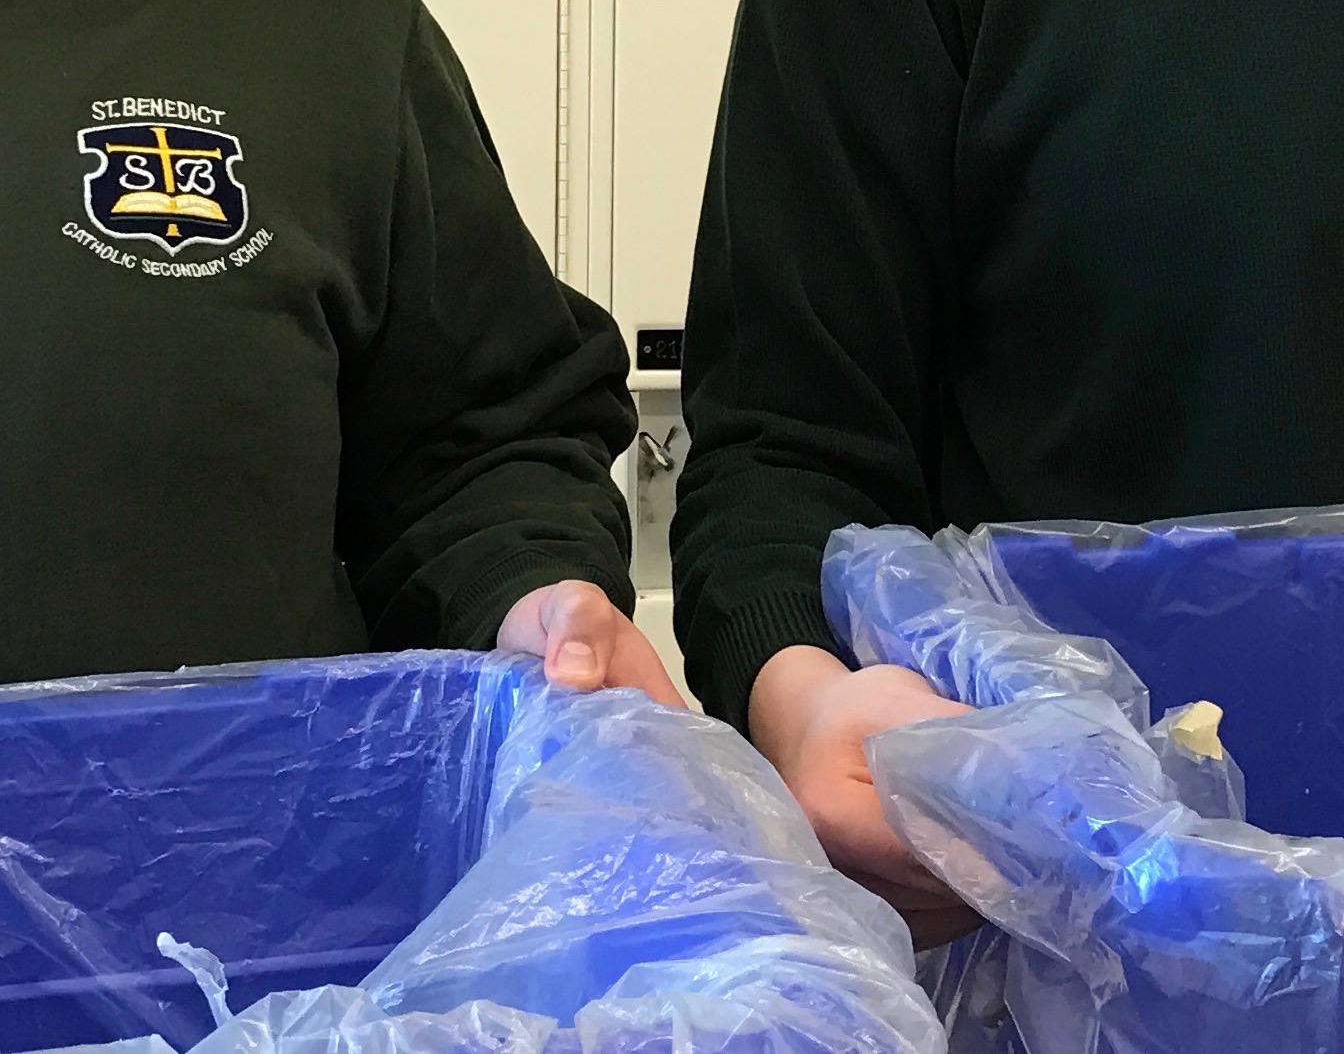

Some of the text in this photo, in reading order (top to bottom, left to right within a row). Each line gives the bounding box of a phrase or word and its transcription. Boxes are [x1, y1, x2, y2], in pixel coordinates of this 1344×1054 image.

[119, 154, 216, 196] S B
[61, 222, 274, 278] CATHOLIC SECONDARY SCHOOL
